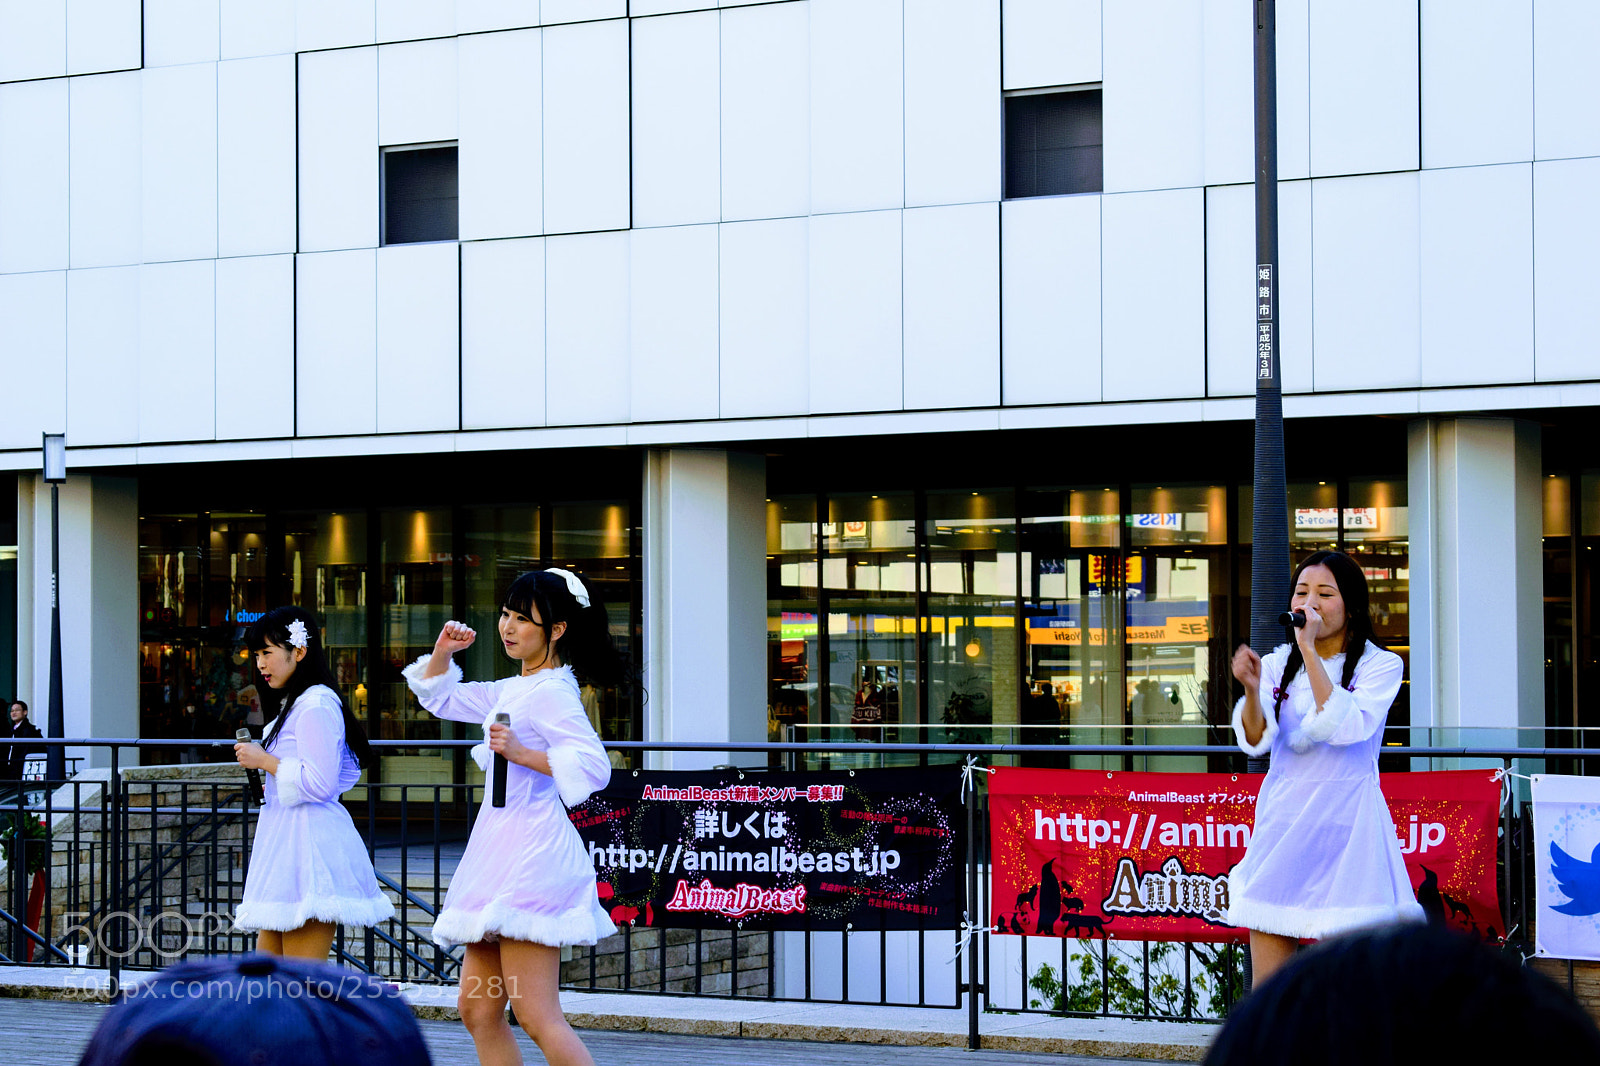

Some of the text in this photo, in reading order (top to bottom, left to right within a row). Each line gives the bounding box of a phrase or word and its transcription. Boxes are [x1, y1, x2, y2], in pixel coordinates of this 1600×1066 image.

[1259, 268, 1270, 316] 姫路市
[1259, 325, 1271, 377] 平成25年3月
[1127, 790, 1205, 804] AnimalBeast
[694, 809, 788, 839] 詳しくは
[1395, 814, 1446, 854] .jp
[588, 841, 900, 876] http://animalbeast.jp
[666, 879, 807, 916] AnimalBeast
